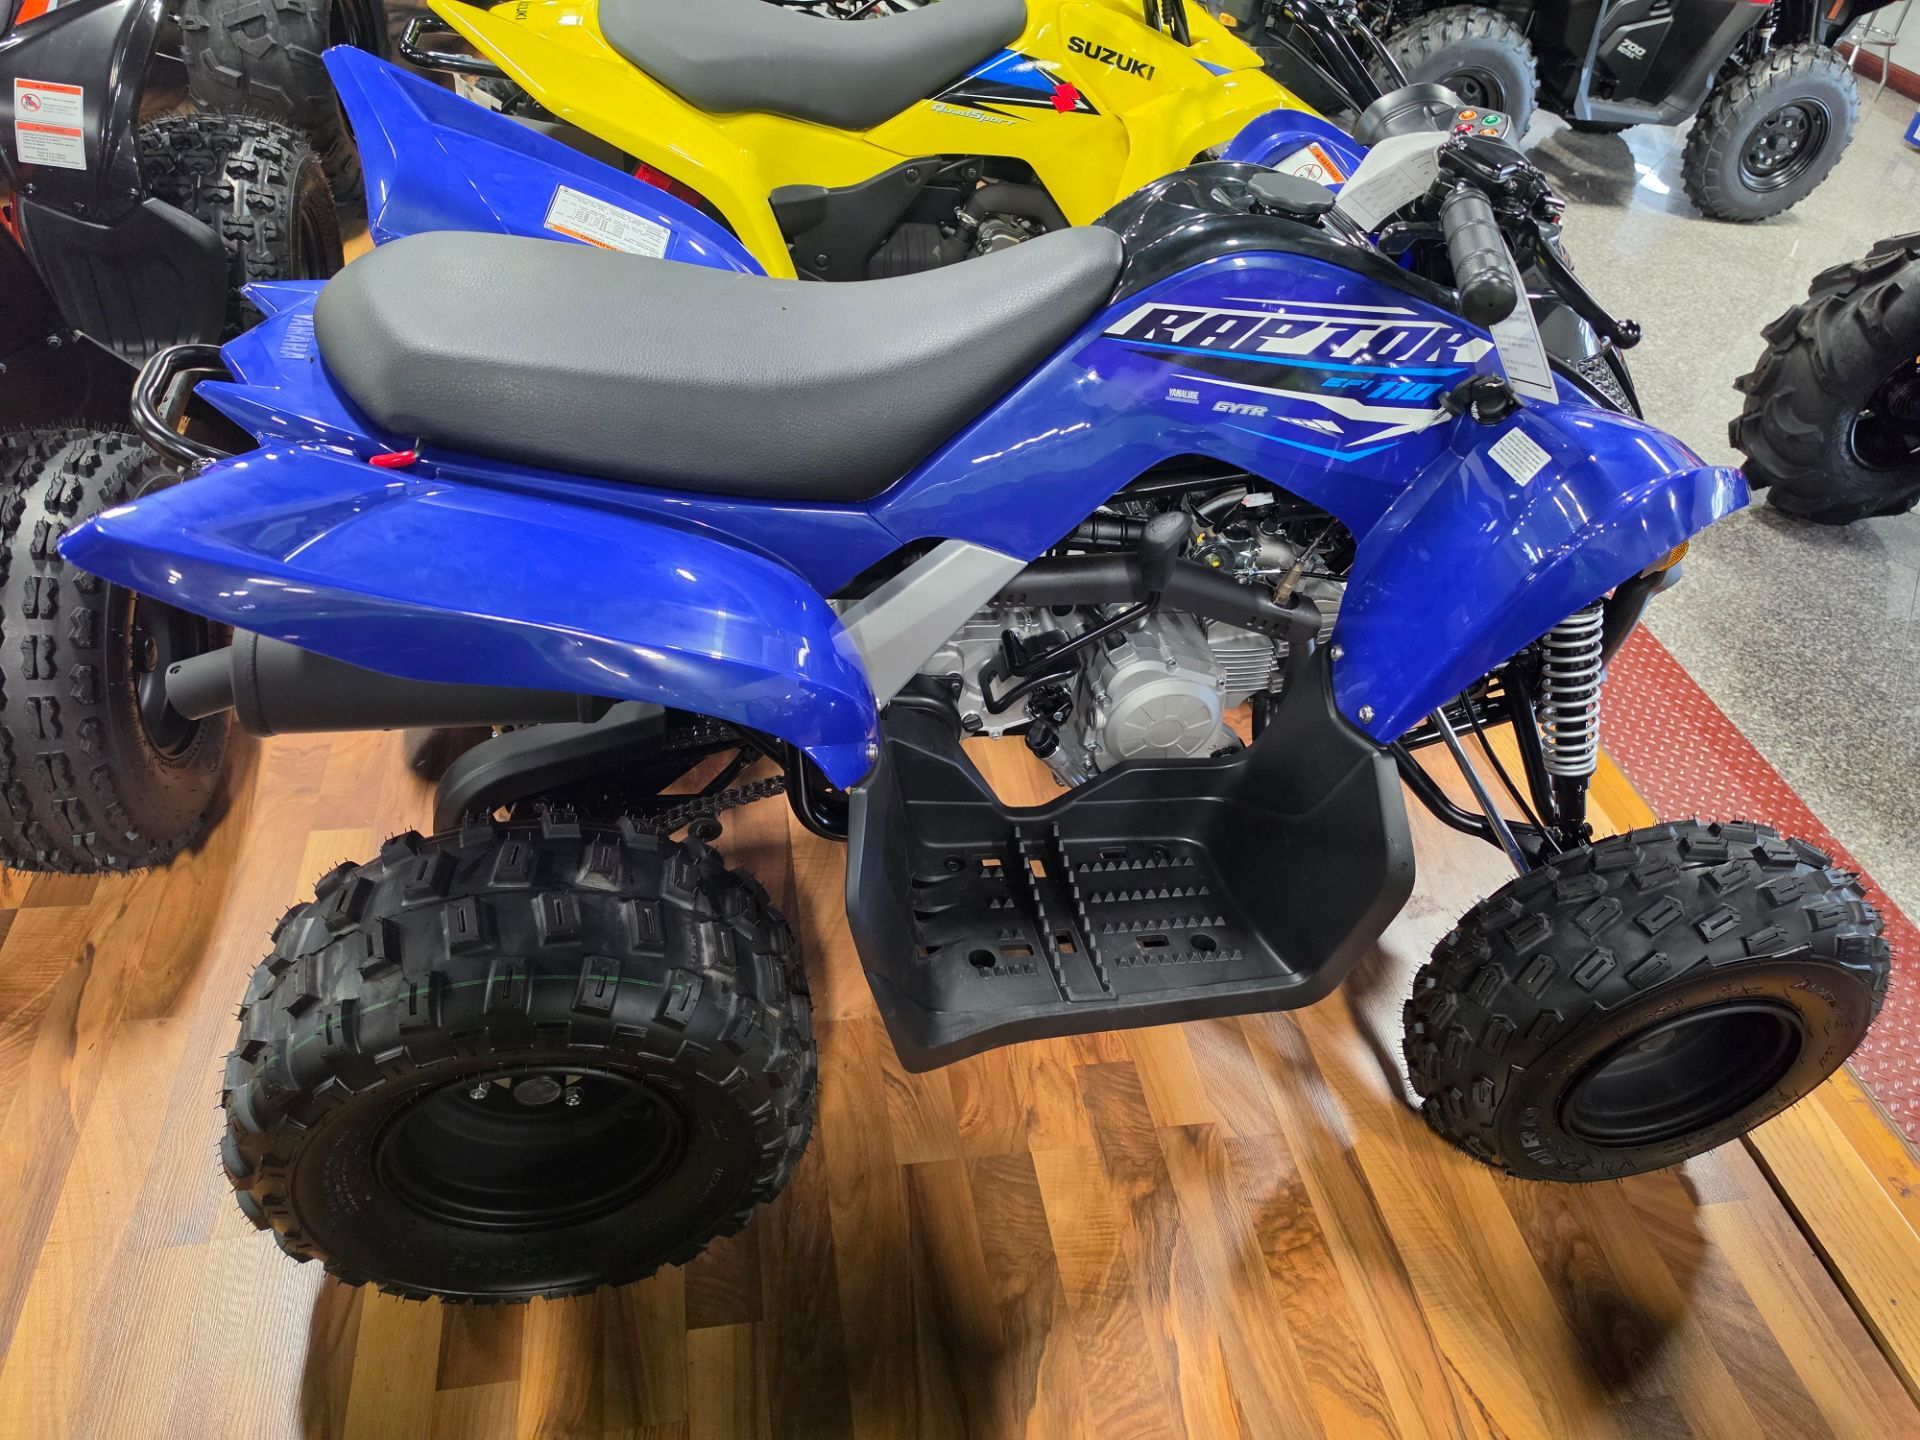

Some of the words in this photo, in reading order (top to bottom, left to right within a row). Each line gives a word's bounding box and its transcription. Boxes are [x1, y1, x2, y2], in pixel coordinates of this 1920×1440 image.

[1067, 36, 1156, 81] SUZUKI
[1620, 38, 1647, 57] 700
[277, 314, 314, 359] YAMAHA
[1114, 306, 1492, 362] RAPTOR
[1320, 377, 1375, 389] EFI
[1366, 381, 1444, 400] 110
[1211, 401, 1269, 418] GYTR
